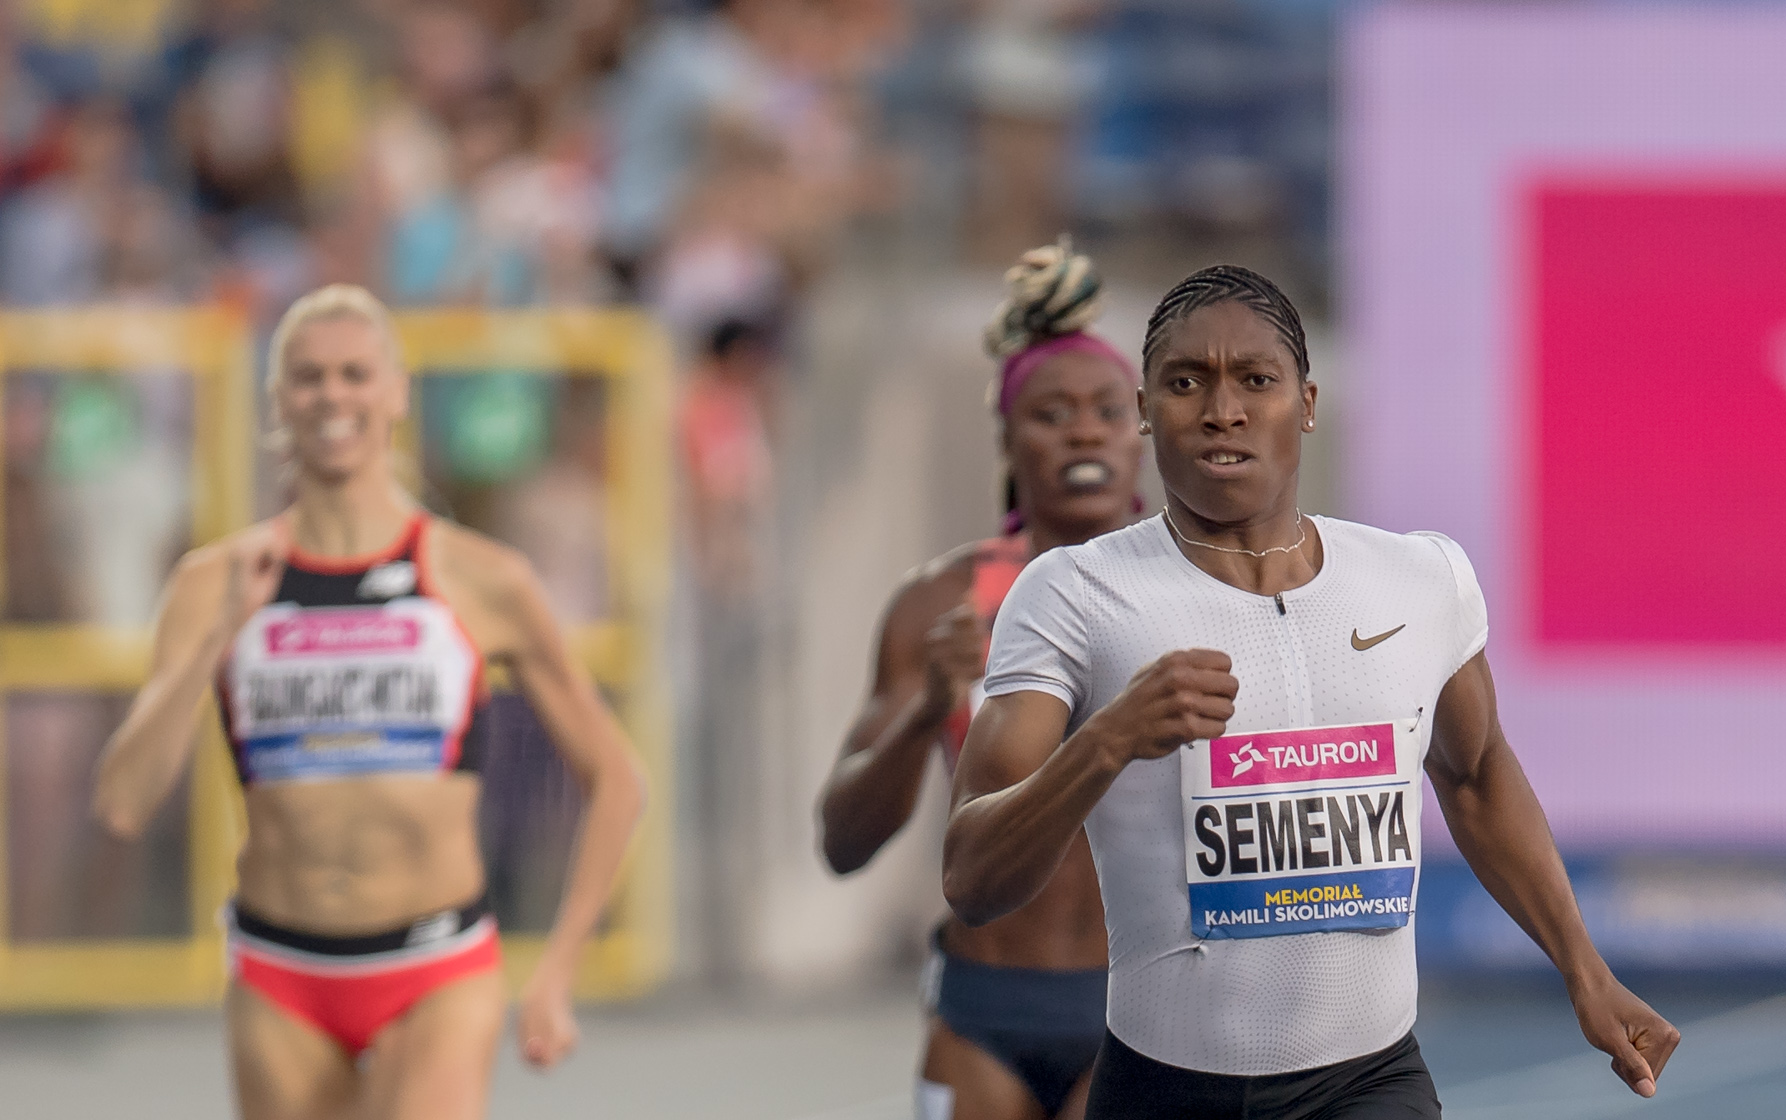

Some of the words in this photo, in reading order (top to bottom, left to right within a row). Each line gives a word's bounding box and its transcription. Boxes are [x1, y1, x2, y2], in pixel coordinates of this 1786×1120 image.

[1267, 739, 1378, 769] TAURON
[1194, 790, 1413, 877] SEMENYA
[1265, 883, 1364, 906] MEMORIAŁ
[1204, 907, 1270, 927] KAMILI
[1274, 896, 1411, 922] SKOLIMOWSKIE
